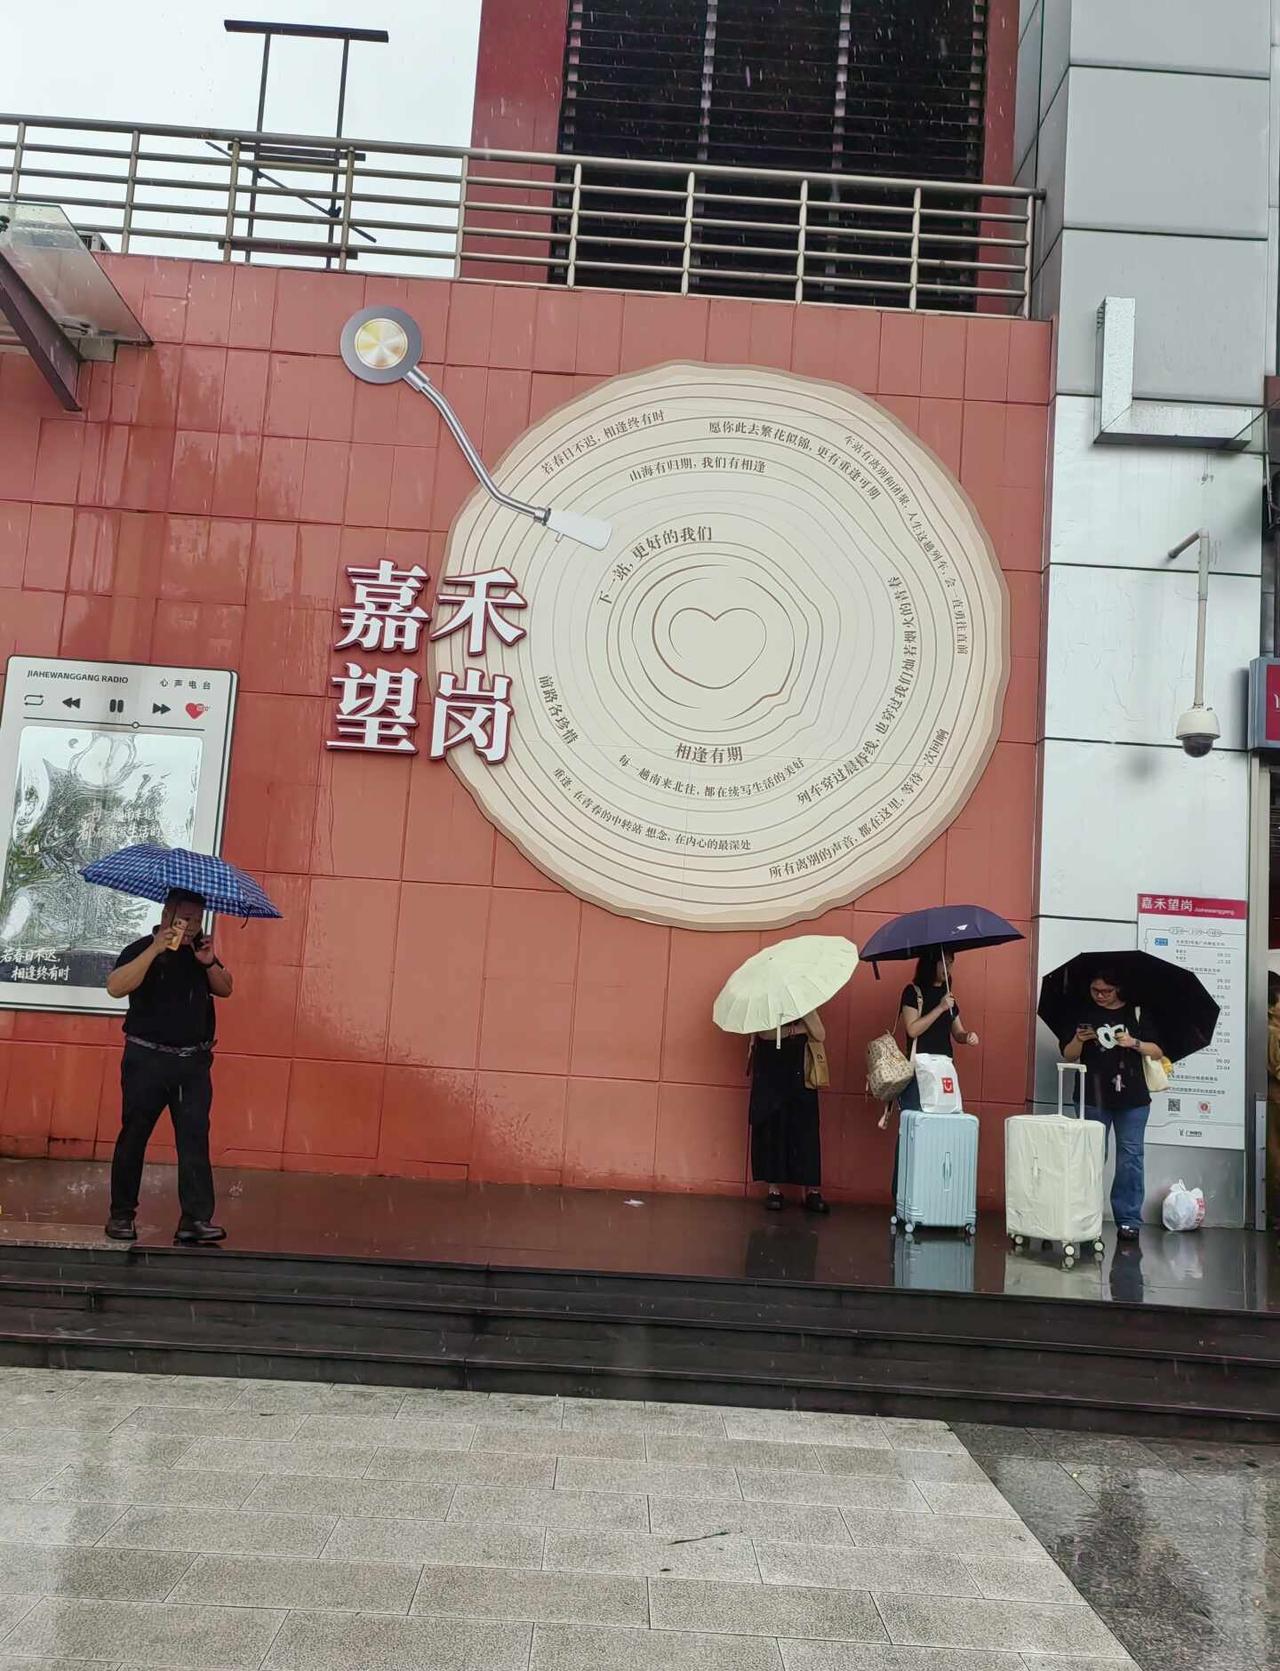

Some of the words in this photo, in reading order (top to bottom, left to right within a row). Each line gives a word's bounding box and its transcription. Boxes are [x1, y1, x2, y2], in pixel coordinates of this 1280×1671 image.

[541, 409, 665, 476] 若春日不迟，相逢终有时
[629, 456, 767, 482] 山海有归期，我们有相逢
[708, 420, 882, 501] 愿你此去繁花似锦，更有重逢可期
[597, 526, 713, 606] 下一站，更好的我们
[334, 558, 528, 657] 嘉禾
[26, 669, 100, 683] JIAHEWANGGANG
[101, 674, 129, 685] RADIO
[538, 674, 581, 745] 前路各珍惜
[325, 661, 515, 765] 望岗
[619, 754, 804, 798] 每一趟南来北往，都在续写生活的美好
[676, 743, 743, 765] 相逢有期
[11, 964, 71, 981] 相逢终有时
